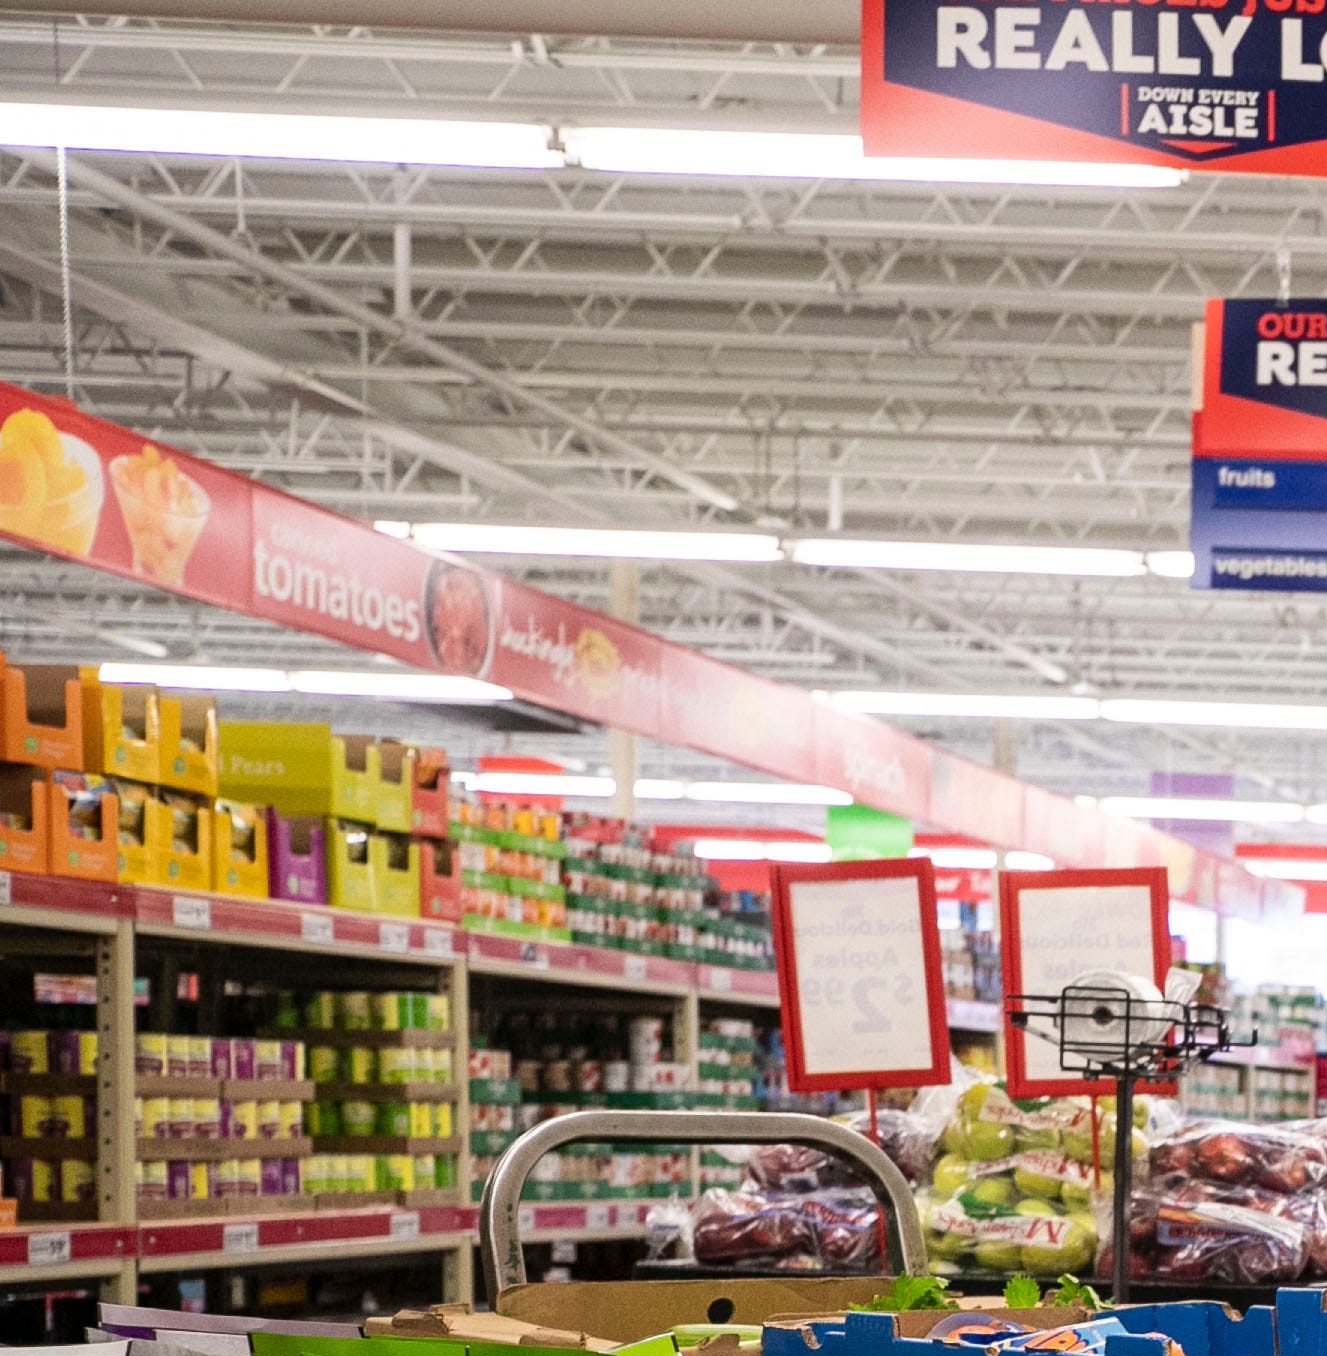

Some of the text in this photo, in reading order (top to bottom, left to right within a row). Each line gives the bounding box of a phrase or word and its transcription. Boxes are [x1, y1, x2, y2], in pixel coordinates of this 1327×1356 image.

[935, 8, 1252, 78] REALLY
[1137, 86, 1260, 108] DOWN EVERY
[1137, 106, 1259, 139] AISLE
[1217, 466, 1277, 489] fruits
[252, 539, 422, 643] tomatoes
